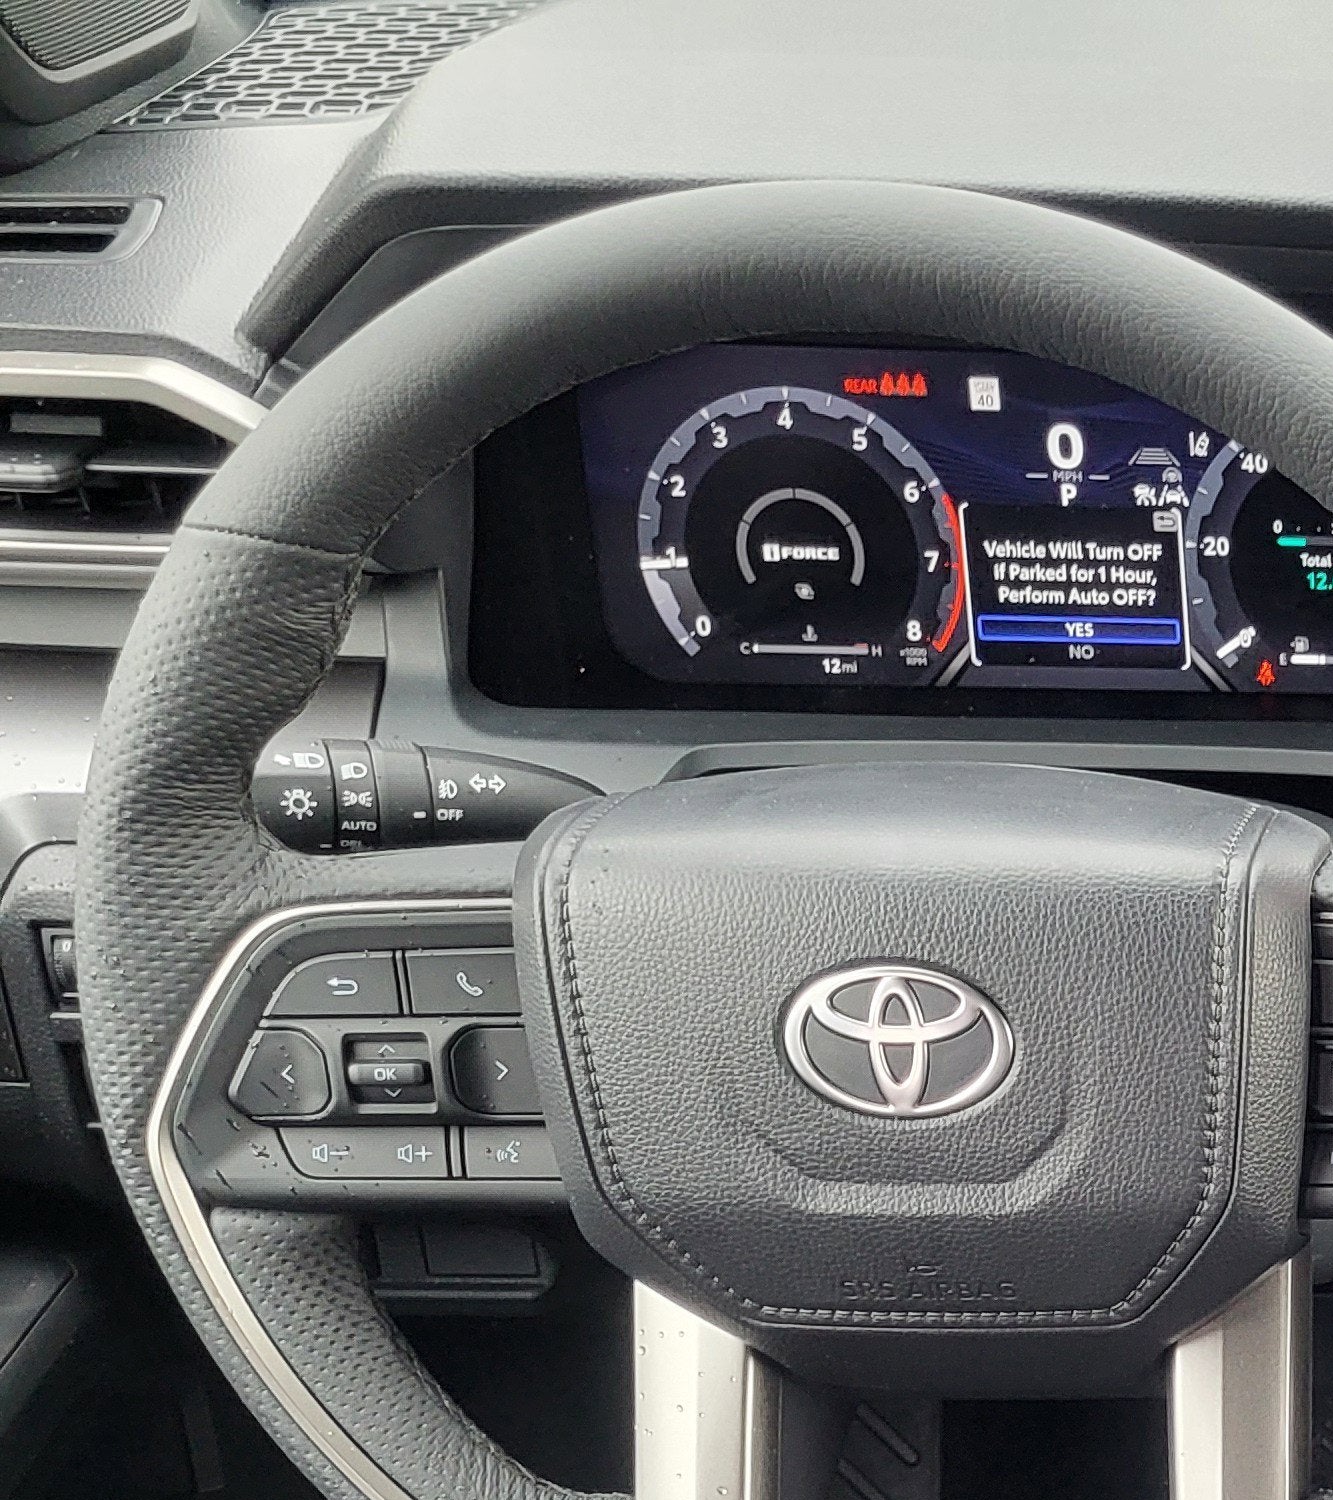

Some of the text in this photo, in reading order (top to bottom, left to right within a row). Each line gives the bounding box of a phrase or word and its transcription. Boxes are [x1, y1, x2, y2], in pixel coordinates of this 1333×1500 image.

[977, 394, 994, 407] 40
[776, 405, 793, 430] 4
[713, 426, 728, 449] 3
[853, 426, 868, 451] 5
[1046, 422, 1084, 470] 0
[1240, 453, 1268, 475] 40
[670, 475, 686, 498] 2
[903, 481, 920, 503] 6
[1060, 485, 1077, 507] P
[1272, 518, 1283, 534] 0
[983, 540, 1162, 562] Vehicle Will Turn OFF
[1203, 536, 1230, 557] 20
[923, 550, 939, 573] 7
[1300, 552, 1331, 568] Total
[1009, 563, 1067, 582] Parked
[1070, 564, 1095, 582] for
[1097, 566, 1107, 583] 1
[1111, 565, 1158, 586] Hour,
[998, 586, 1156, 607] Perform Auto OFF?
[695, 614, 711, 637] 0
[906, 619, 922, 641] 8
[1064, 622, 1094, 638] YES
[1068, 645, 1095, 660] NO
[341, 820, 377, 831] AUTO
[437, 808, 464, 821] OFF
[374, 1067, 397, 1081] OK
